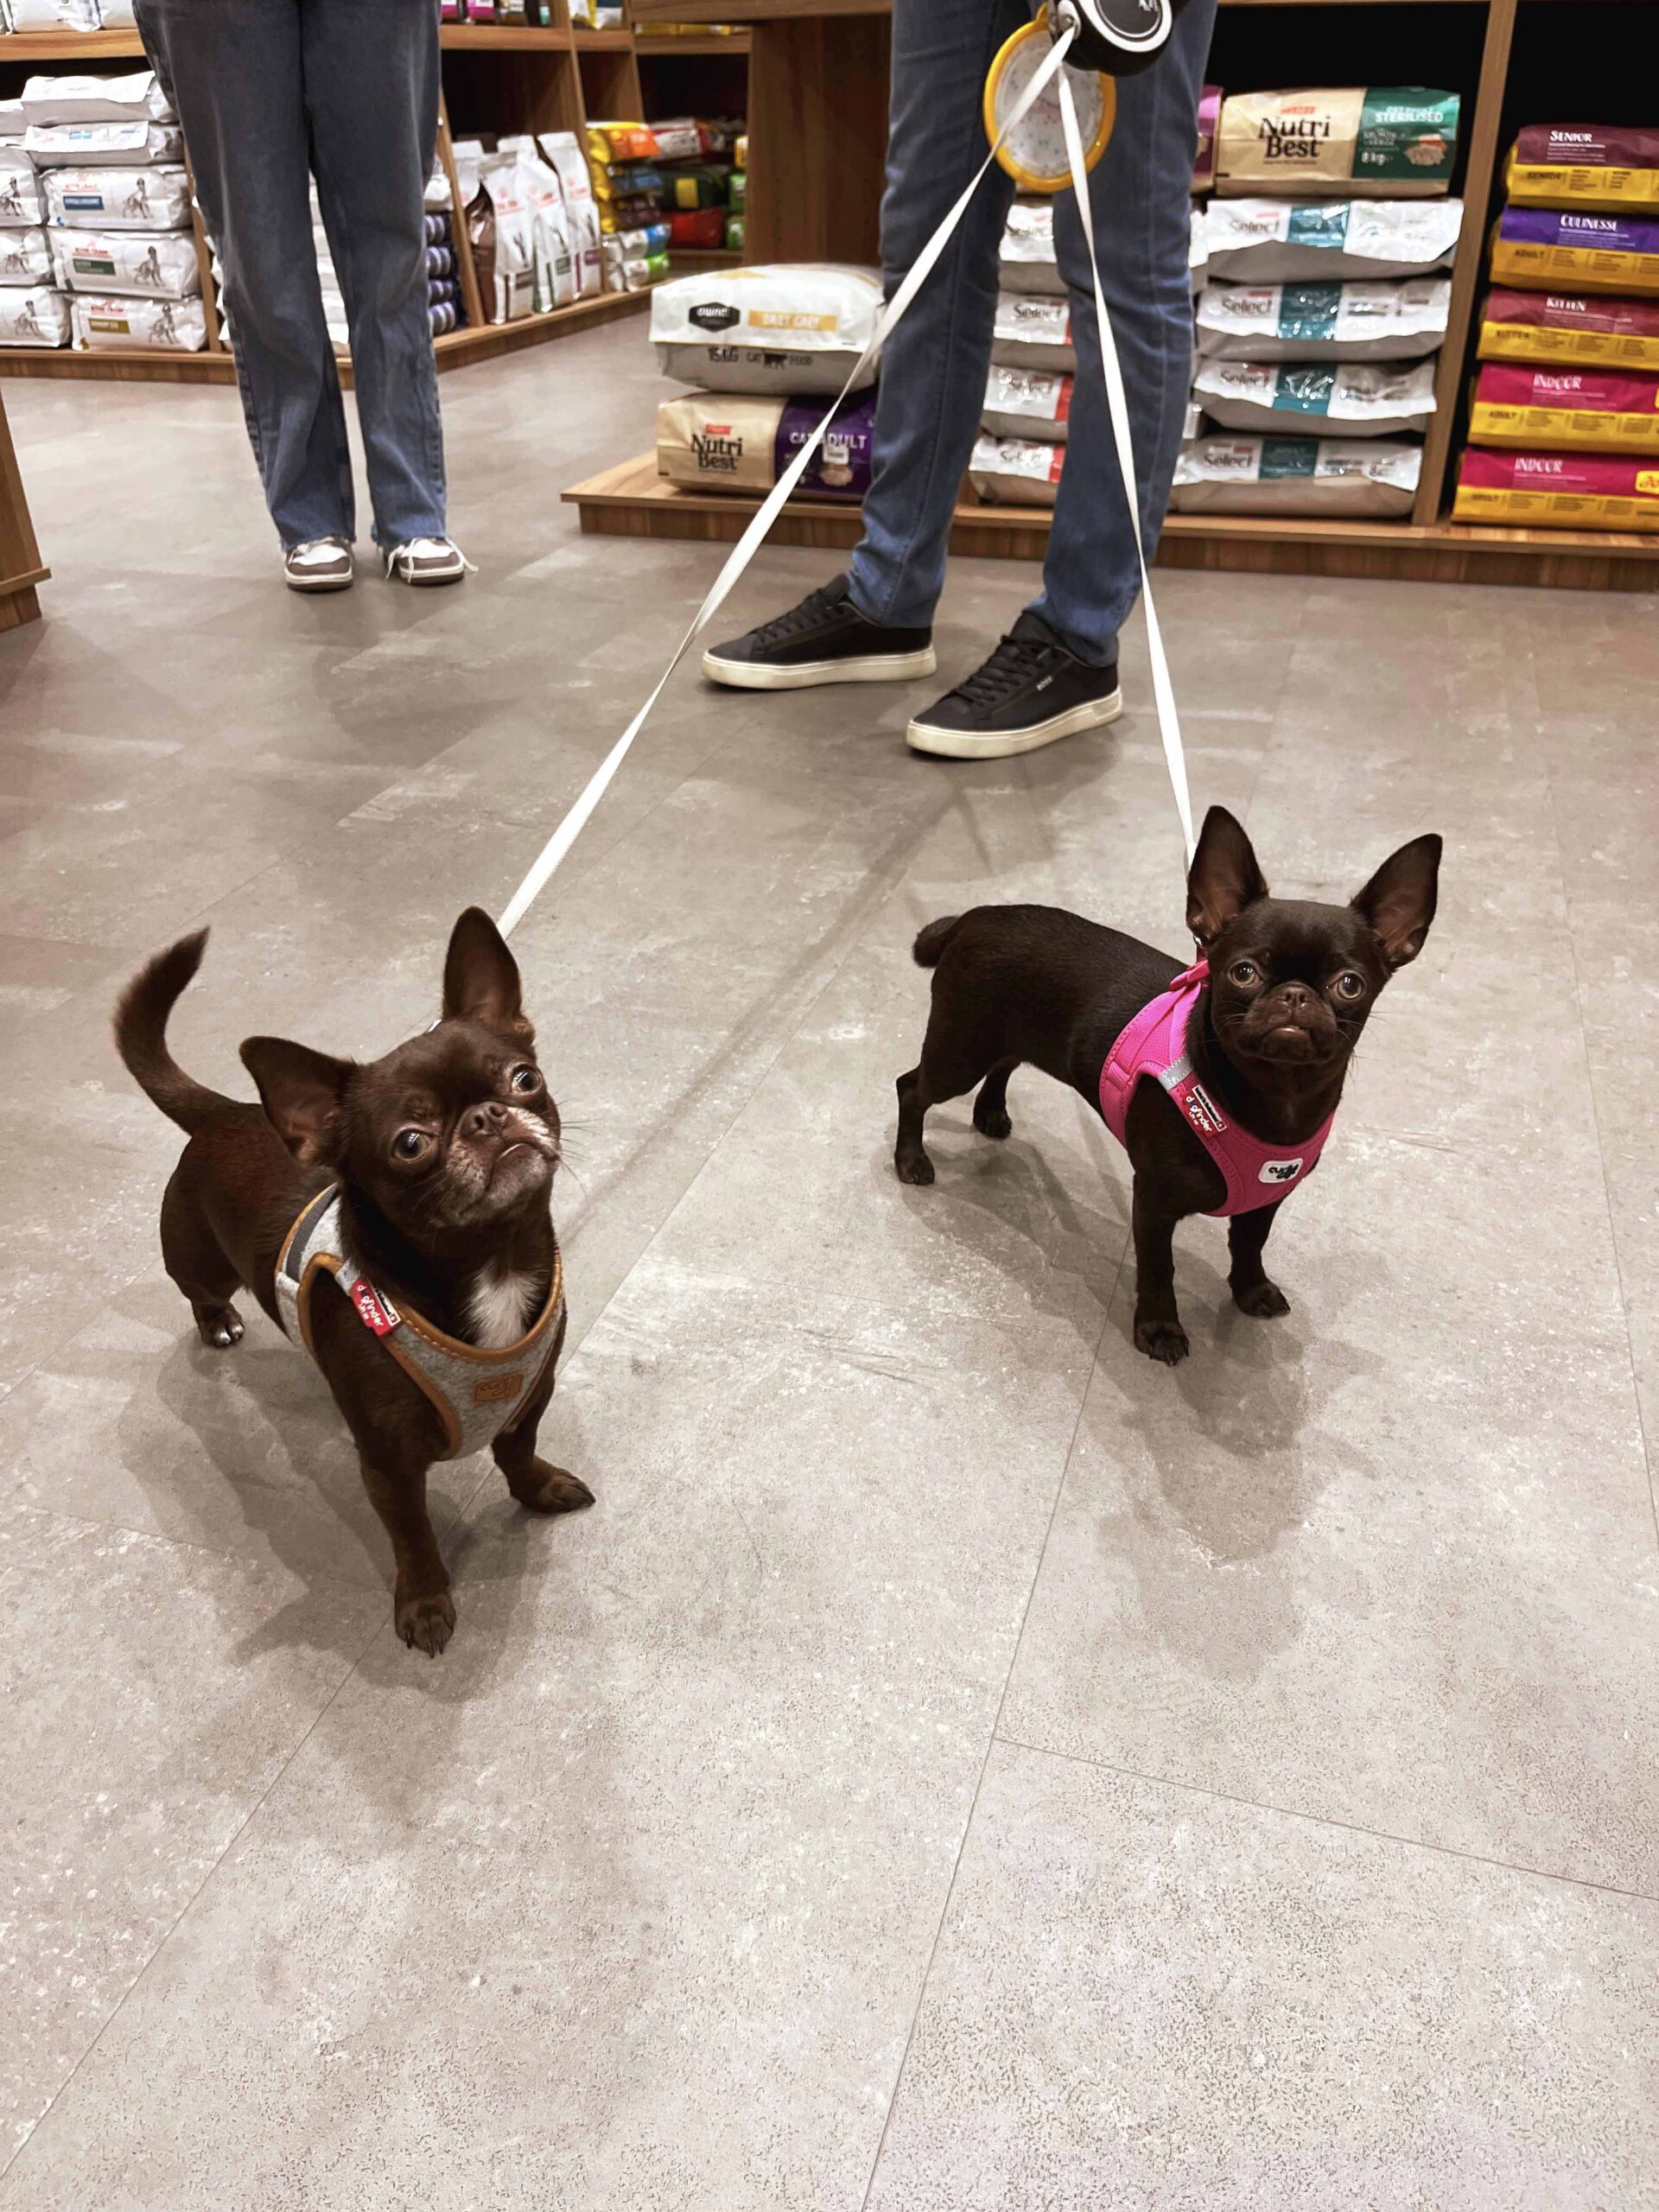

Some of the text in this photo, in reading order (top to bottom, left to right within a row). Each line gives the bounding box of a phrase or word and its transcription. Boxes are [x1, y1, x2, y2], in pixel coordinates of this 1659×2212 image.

[1258, 116, 1332, 139] Nutri
[1549, 130, 1592, 143] SENIOR
[1265, 136, 1324, 159] Best
[1560, 213, 1618, 232] CULINESSE
[1221, 296, 1273, 315] Select
[1546, 296, 1587, 312] KITTEN
[1219, 369, 1271, 387] Select
[1533, 372, 1583, 391] INDOOR
[690, 433, 744, 457] Nutri
[697, 452, 741, 471] Best
[1203, 452, 1255, 468] Select
[1513, 456, 1564, 474] INDOOR
